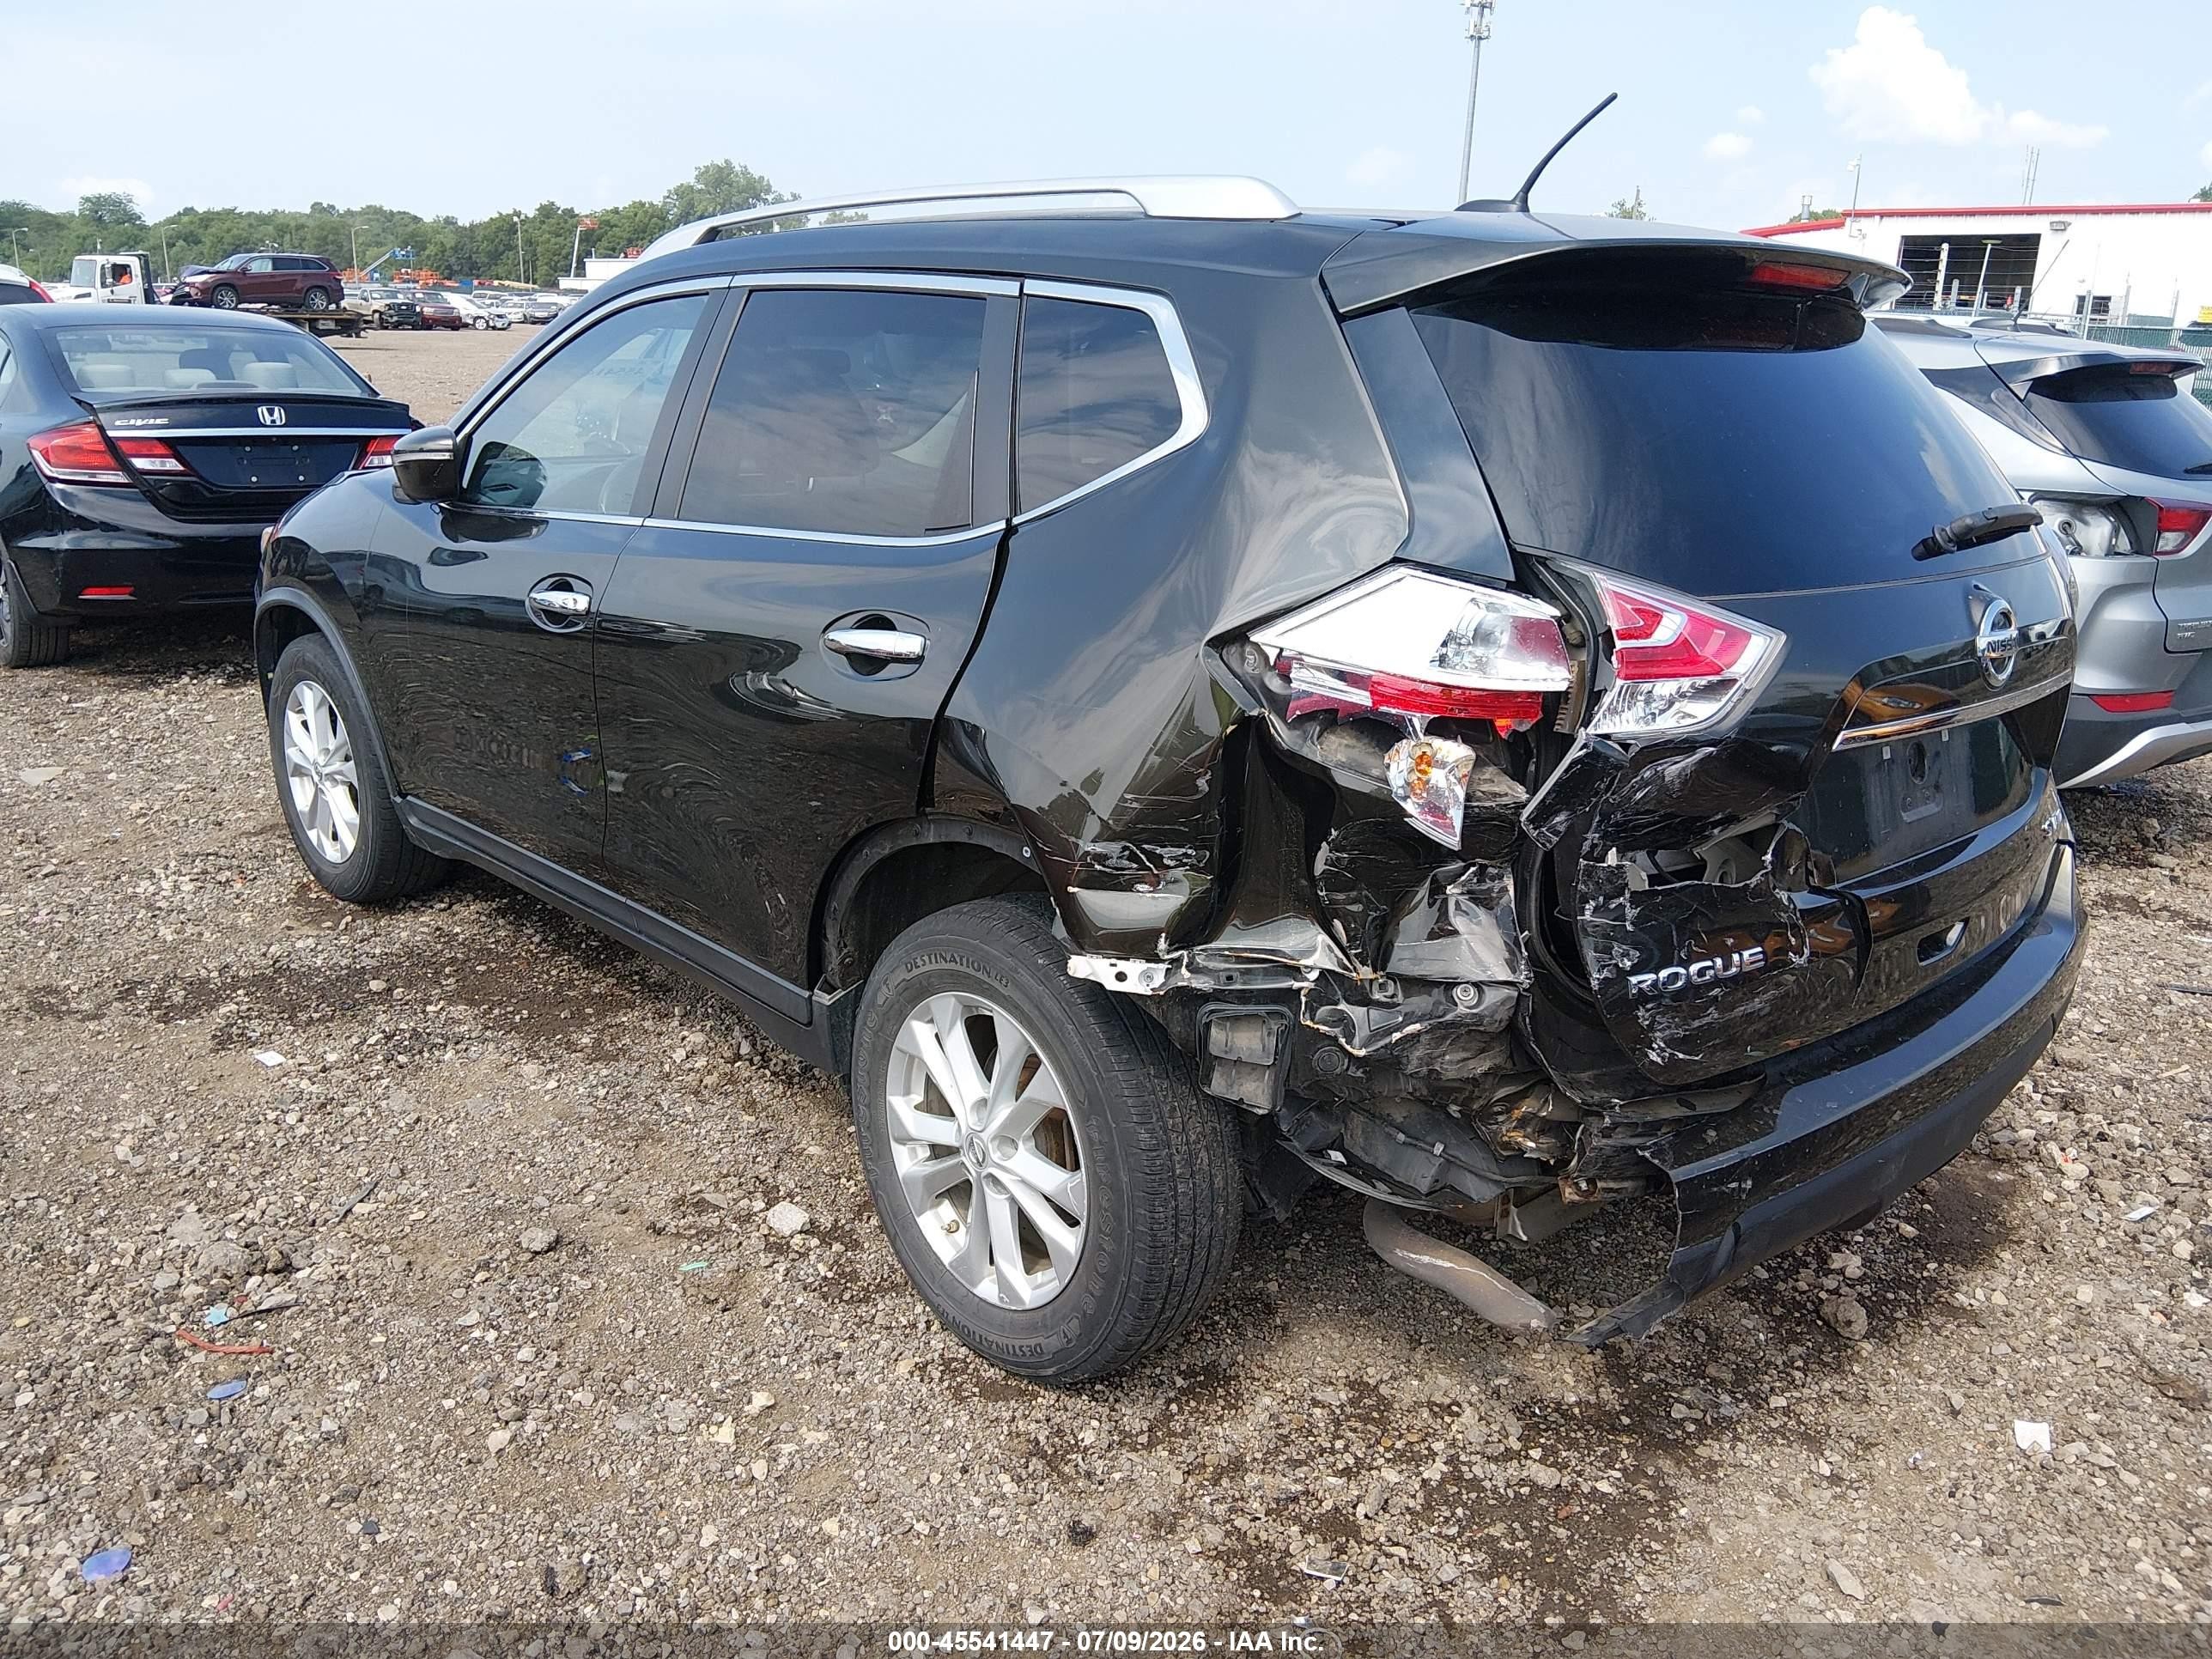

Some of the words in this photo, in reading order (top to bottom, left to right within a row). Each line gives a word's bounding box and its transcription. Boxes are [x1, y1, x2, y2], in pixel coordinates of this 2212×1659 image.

[114, 418, 169, 427] CIVIC
[905, 951, 992, 979] DESTINATION
[994, 972, 1011, 988] LE3
[1626, 946, 1765, 999] ROGUE
[952, 1315, 1044, 1357] DESTINATION
